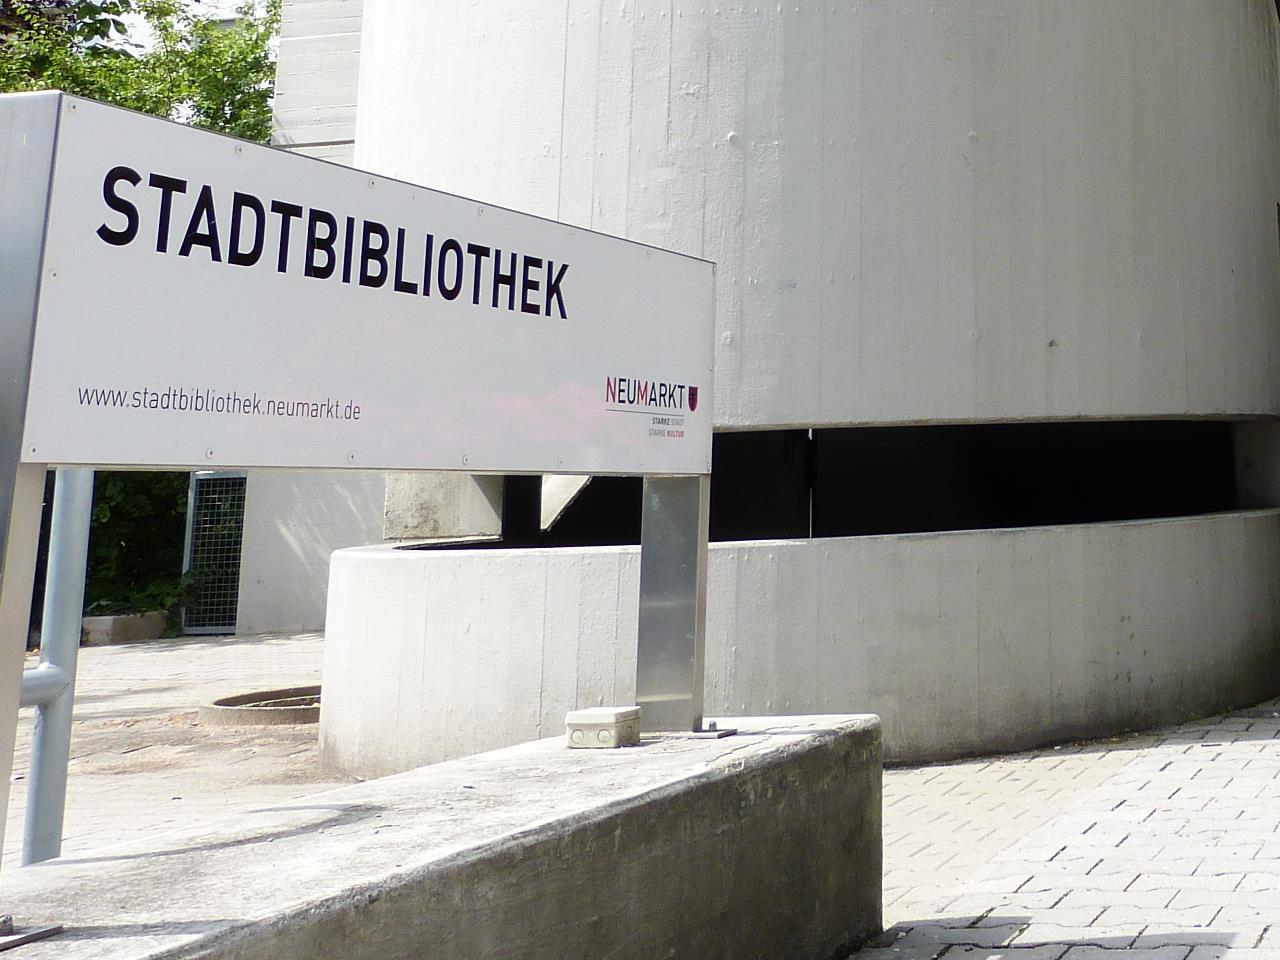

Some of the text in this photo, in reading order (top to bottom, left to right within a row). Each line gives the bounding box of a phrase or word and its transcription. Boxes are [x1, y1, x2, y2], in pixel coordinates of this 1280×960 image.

[96, 165, 569, 320] STADTBIBLIOTHEK
[78, 384, 361, 421] www.stadtbibliothek.neumarkt.de
[606, 376, 685, 409] NEUMARKT
[648, 429, 685, 438] STARKE KULTUR
[652, 417, 670, 426] STARKE
